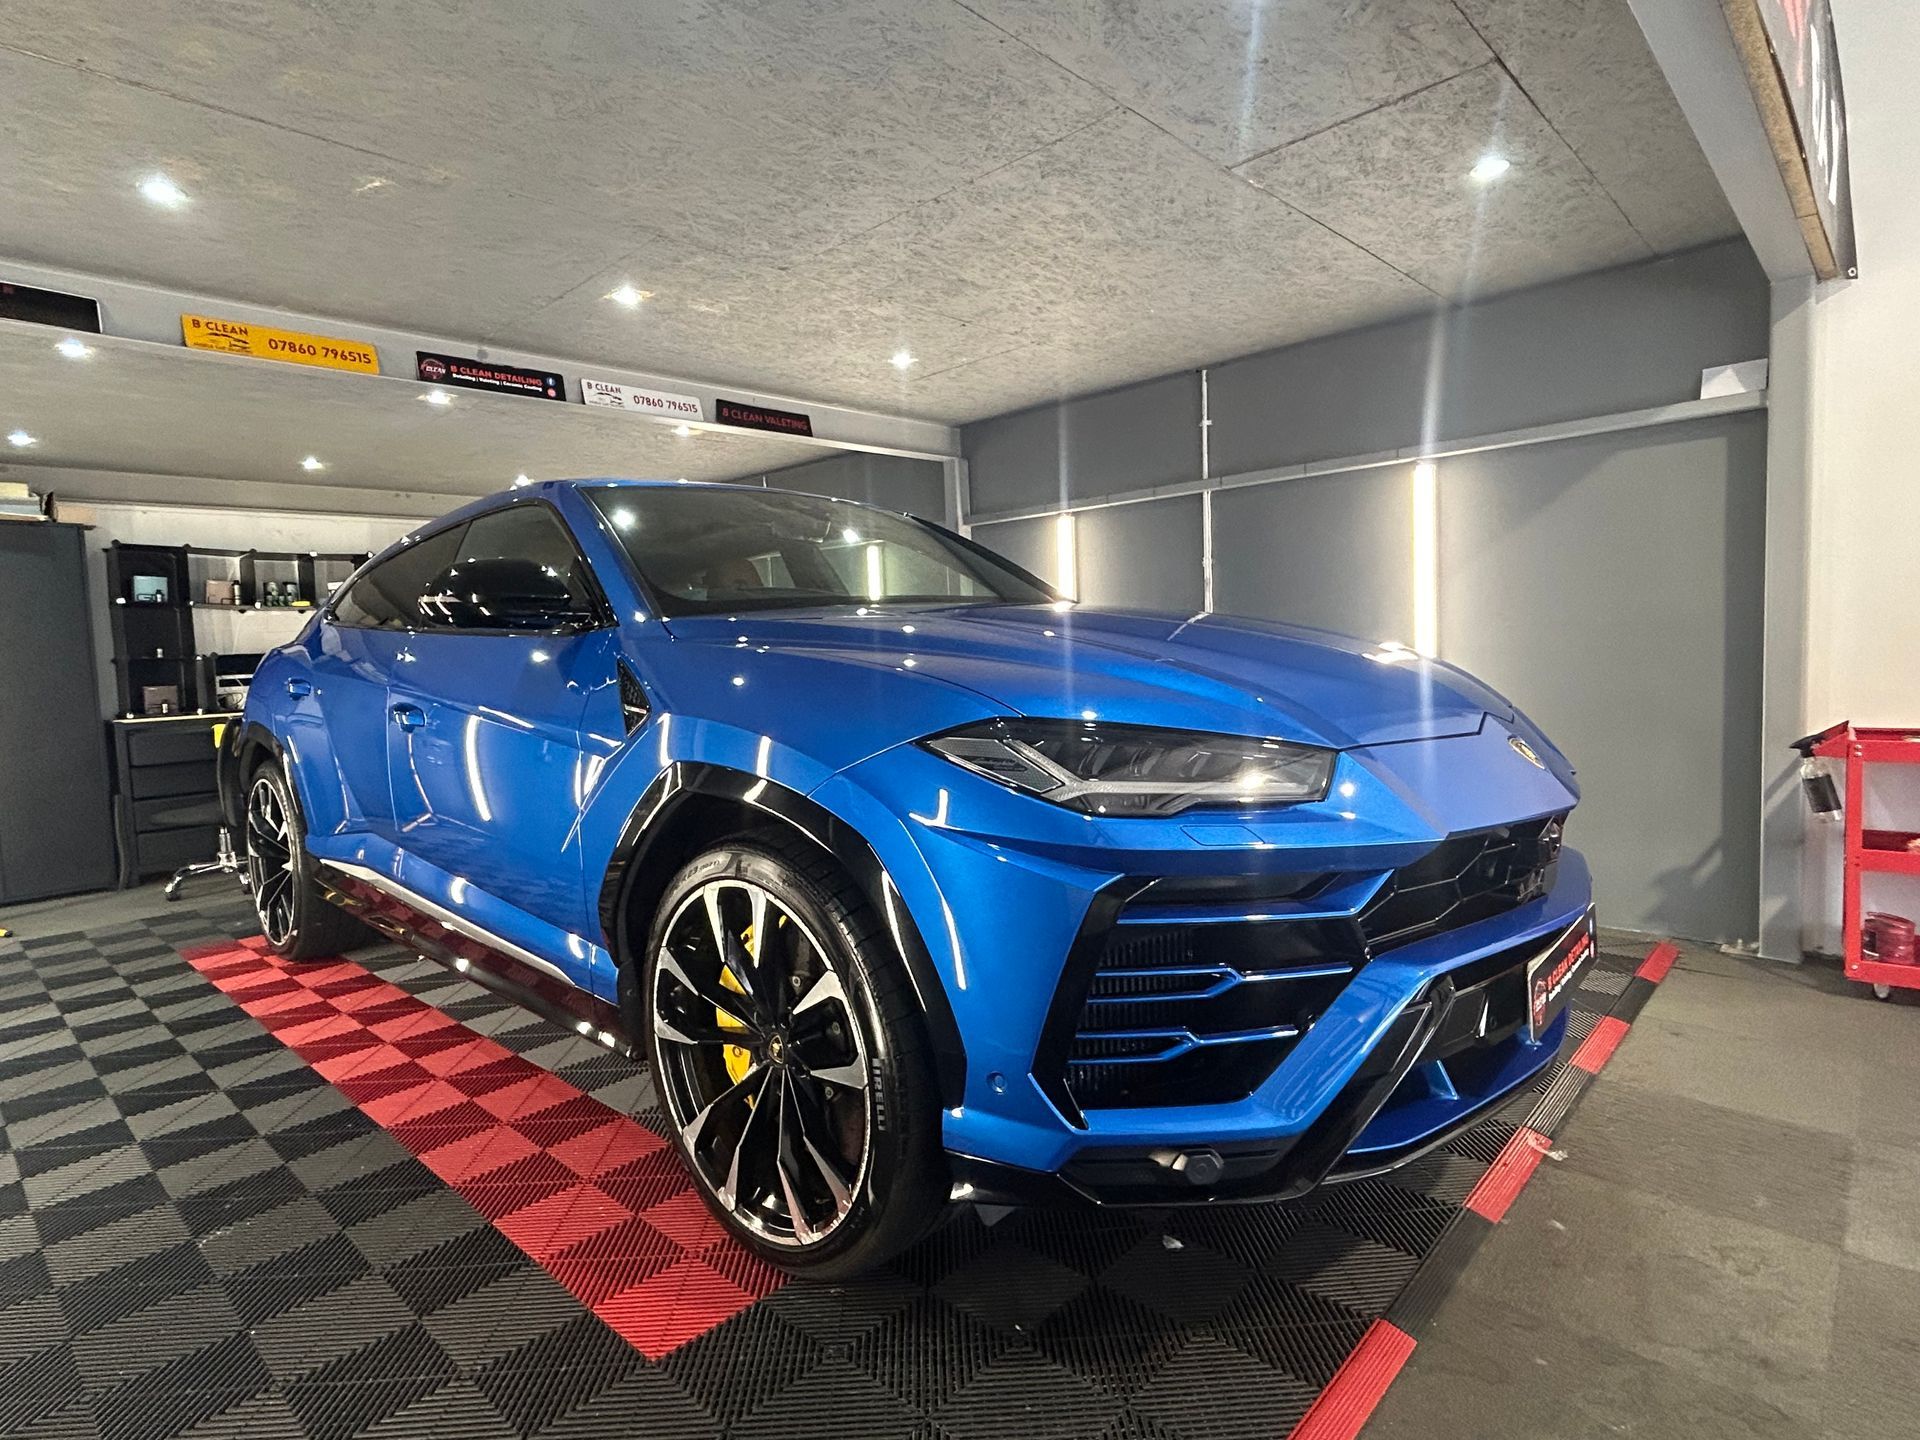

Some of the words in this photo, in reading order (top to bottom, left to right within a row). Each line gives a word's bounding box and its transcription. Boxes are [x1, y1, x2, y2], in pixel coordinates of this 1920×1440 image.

[192, 319, 201, 328] B
[205, 321, 249, 336] CLEAN
[268, 338, 317, 356] 07860
[321, 346, 372, 364] 796515
[450, 365, 458, 373] B
[460, 366, 492, 378] CLEAN
[494, 372, 543, 386] DETAILING
[587, 381, 593, 390] B
[595, 383, 622, 394] CLEAN
[633, 395, 664, 408] 07860
[666, 400, 698, 413] 796515
[731, 409, 763, 422] CLEAN
[764, 415, 808, 431] VALETING
